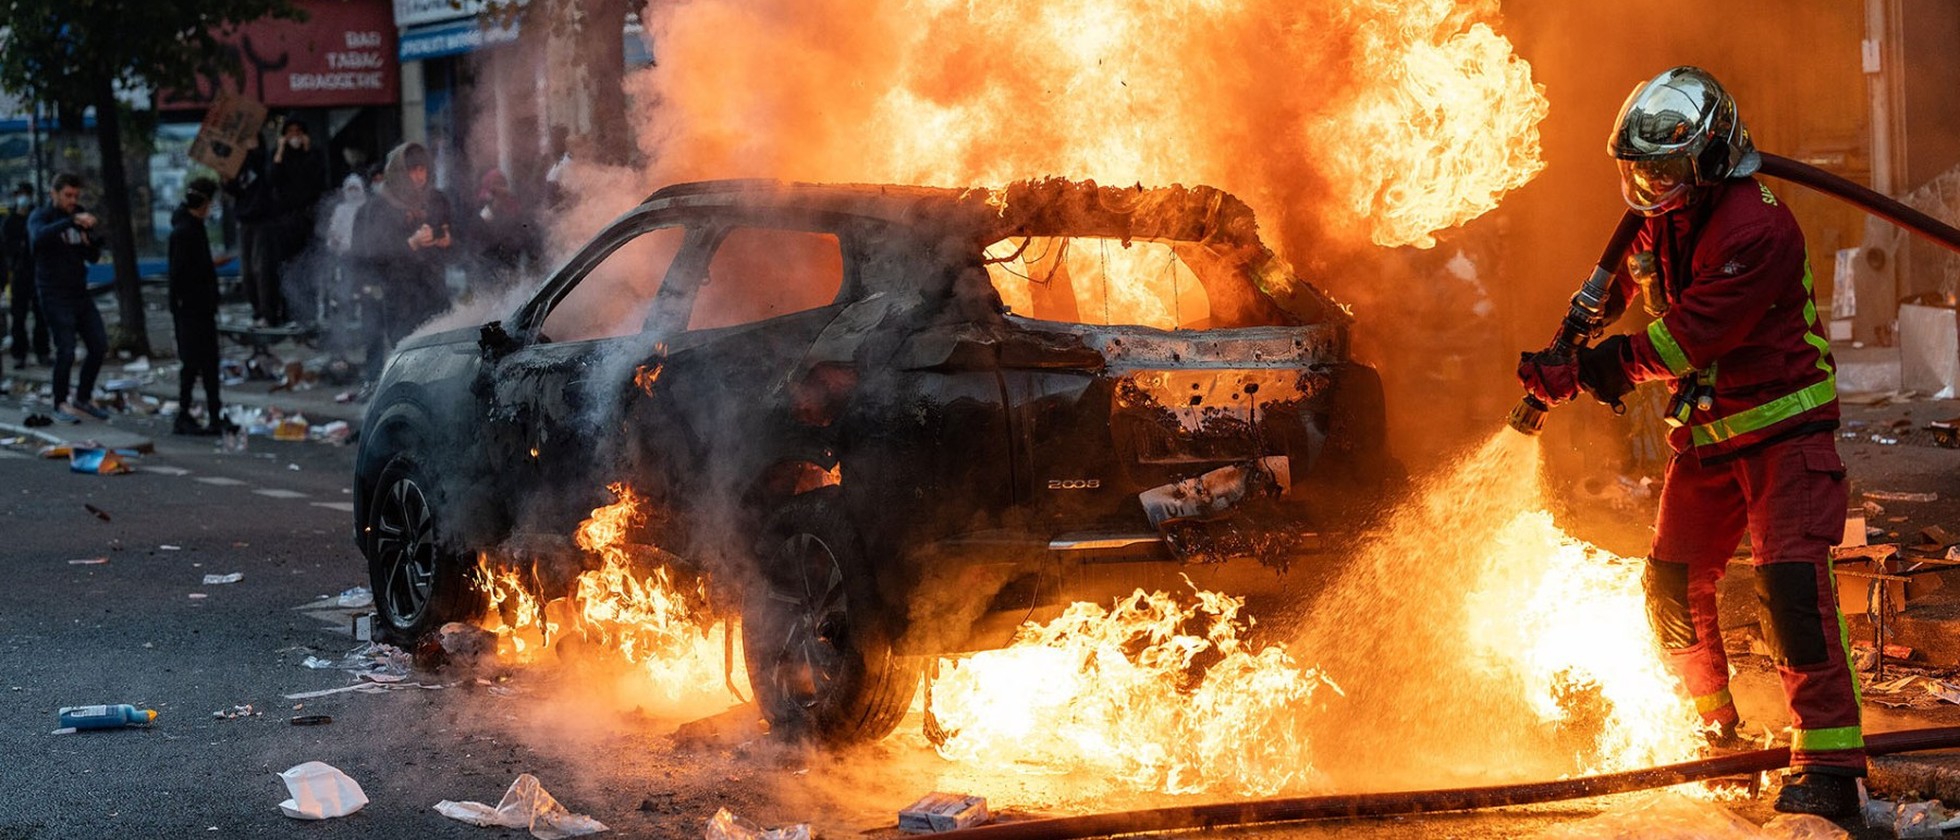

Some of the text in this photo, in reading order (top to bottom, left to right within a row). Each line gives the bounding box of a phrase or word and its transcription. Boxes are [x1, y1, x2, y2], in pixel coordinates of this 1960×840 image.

[345, 31, 381, 48] BAR
[327, 52, 383, 69] TABAC
[1048, 480, 1100, 489] 2008
